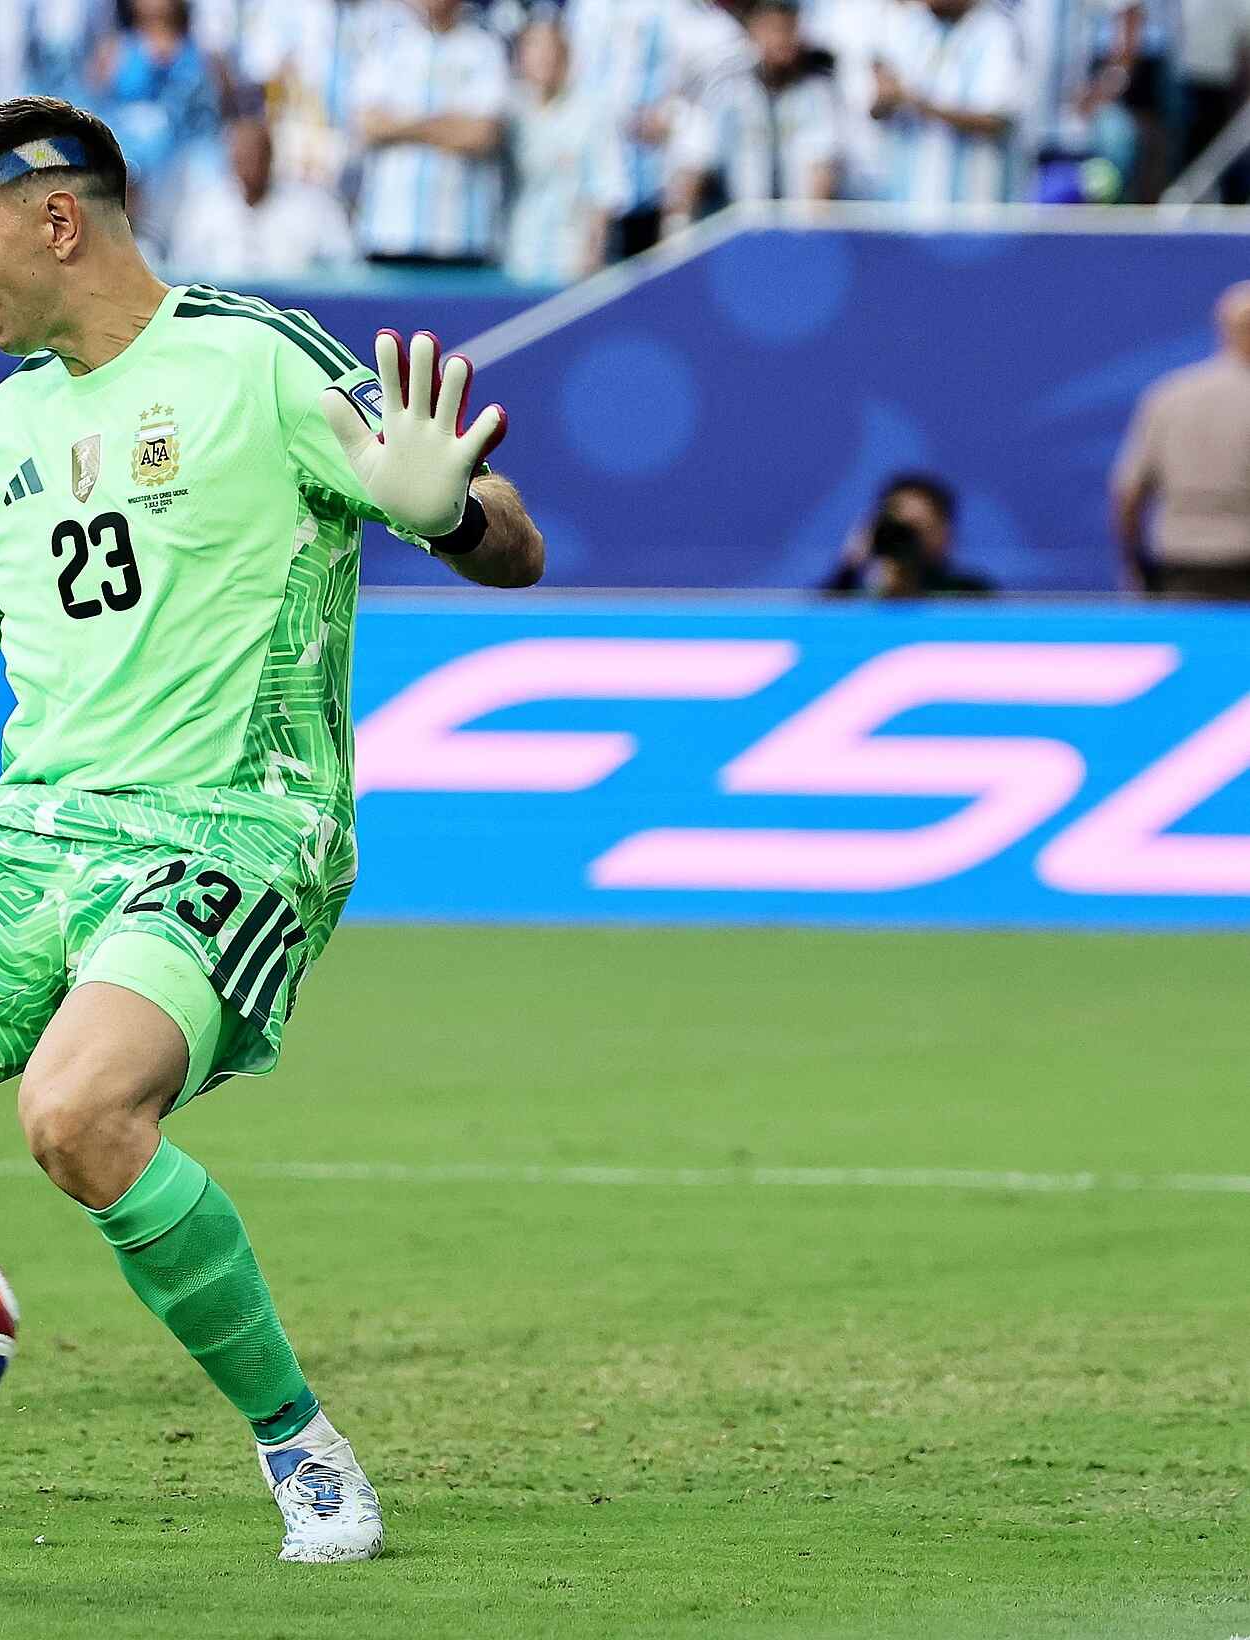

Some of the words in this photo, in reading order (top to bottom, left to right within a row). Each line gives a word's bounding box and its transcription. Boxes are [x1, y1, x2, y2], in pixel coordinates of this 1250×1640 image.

[140, 438, 169, 467] AFA
[52, 511, 141, 619] 23
[123, 860, 241, 937] 23
